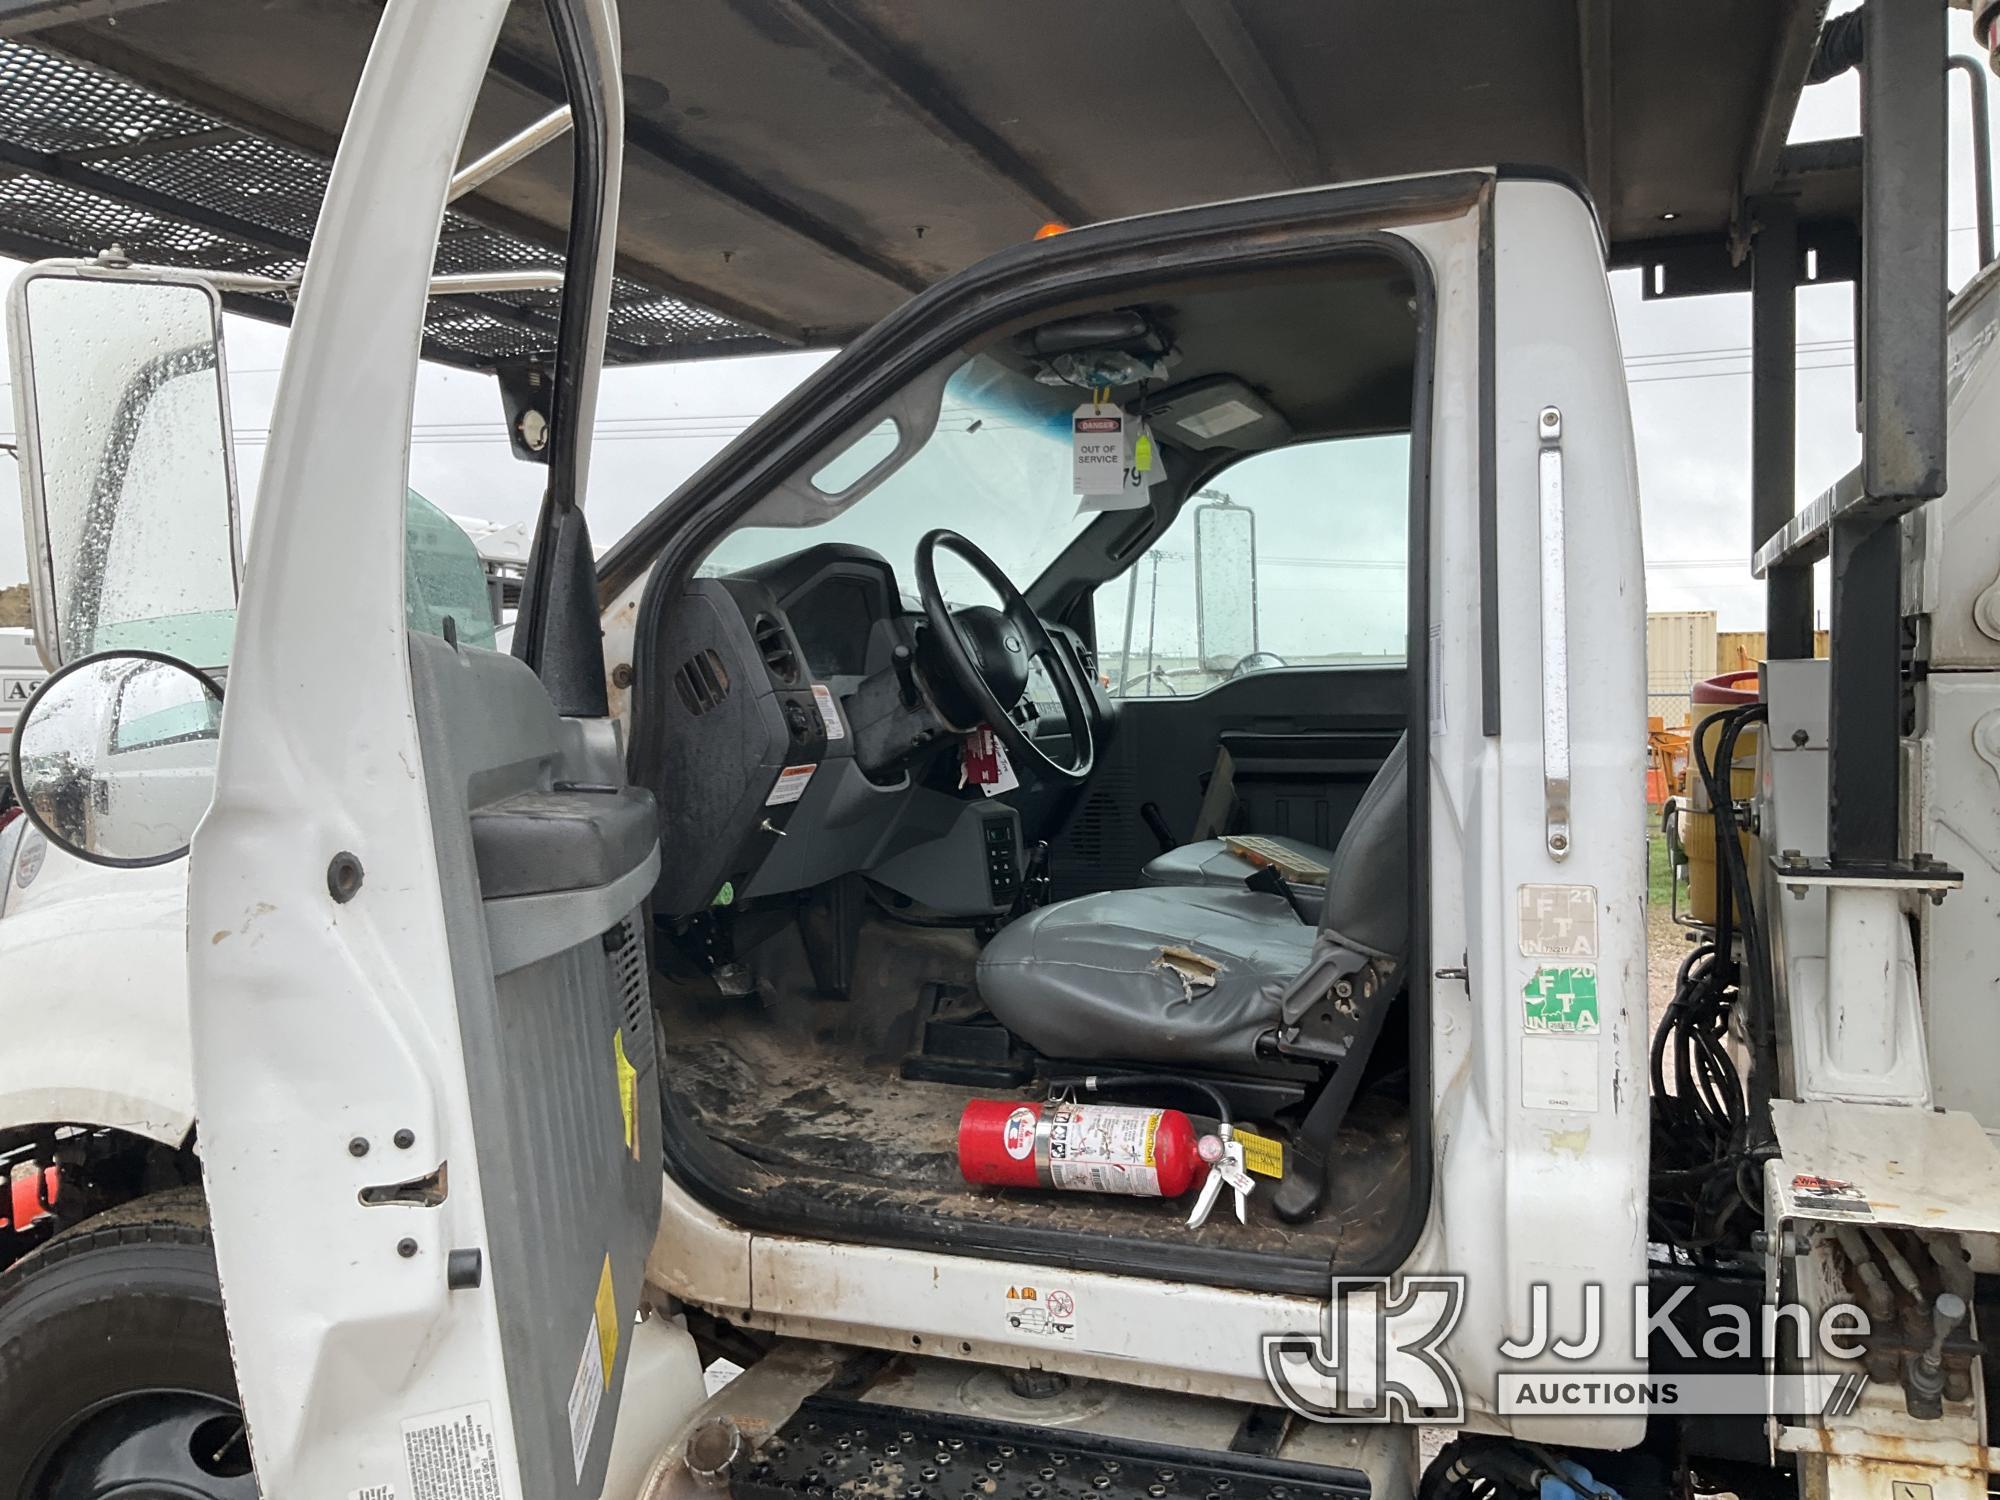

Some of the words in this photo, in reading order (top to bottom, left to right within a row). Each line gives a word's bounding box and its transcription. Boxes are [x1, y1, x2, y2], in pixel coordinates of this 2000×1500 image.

[1082, 421, 1115, 429] DANGER
[1080, 445, 1100, 453] OUT
[1102, 445, 1116, 453] OF
[1078, 455, 1118, 464] SERVICE
[1570, 889, 1591, 903] 21
[1523, 939, 1542, 953] IN
[1528, 1016, 1546, 1029] IN
